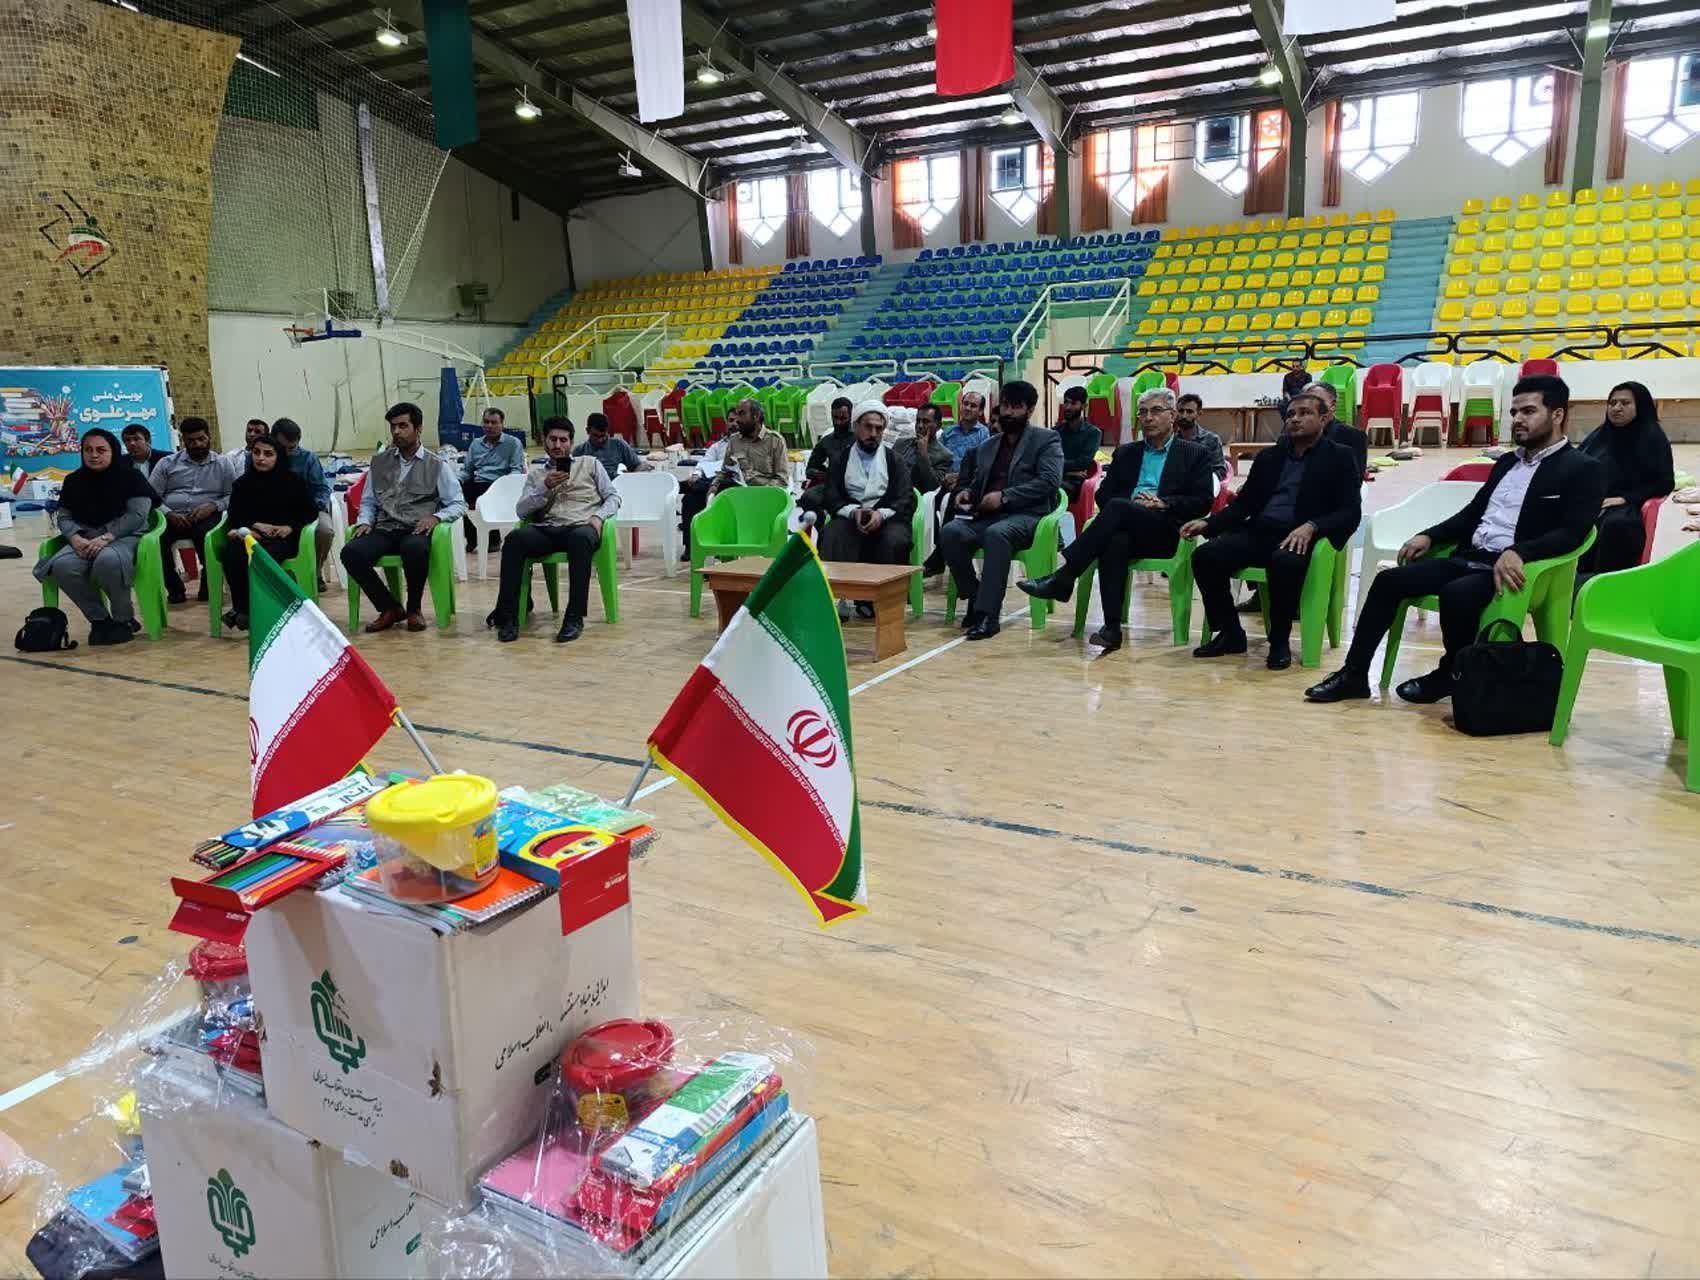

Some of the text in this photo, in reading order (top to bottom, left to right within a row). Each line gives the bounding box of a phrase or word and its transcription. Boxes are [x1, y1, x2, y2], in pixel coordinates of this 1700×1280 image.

[92, 390, 143, 402] پویش ملی
[80, 404, 157, 422] مهر علوی
